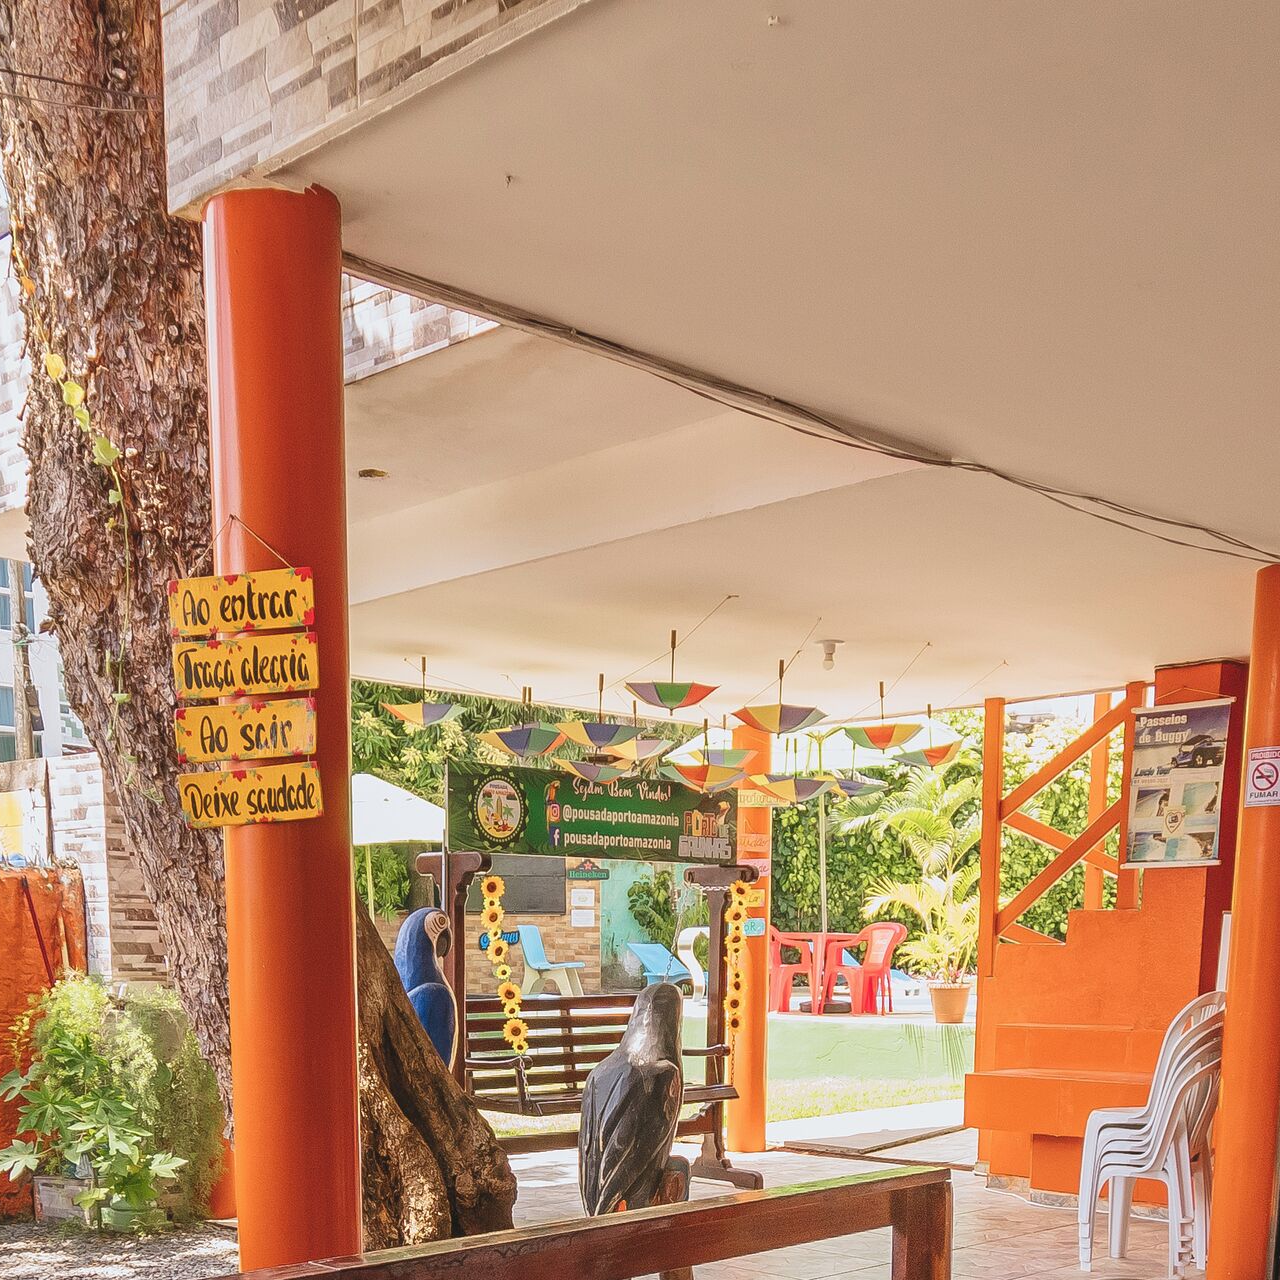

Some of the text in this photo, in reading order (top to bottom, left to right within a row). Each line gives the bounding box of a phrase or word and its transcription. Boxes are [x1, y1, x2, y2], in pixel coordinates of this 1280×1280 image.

[182, 582, 297, 627] Ao entrar
[1140, 714, 1188, 728] Passeios
[200, 714, 293, 754] Ao sair
[1139, 729, 1191, 743] de Buggy
[185, 772, 316, 820] Deixe saudade
[573, 777, 604, 802] Sejam
[608, 781, 633, 798] Bem
[1249, 790, 1279, 798] FUMAR
[562, 805, 680, 827] @pousadaportoamazonia
[564, 831, 672, 850] pousadaportoamazonia
[568, 870, 608, 879] Heineken
